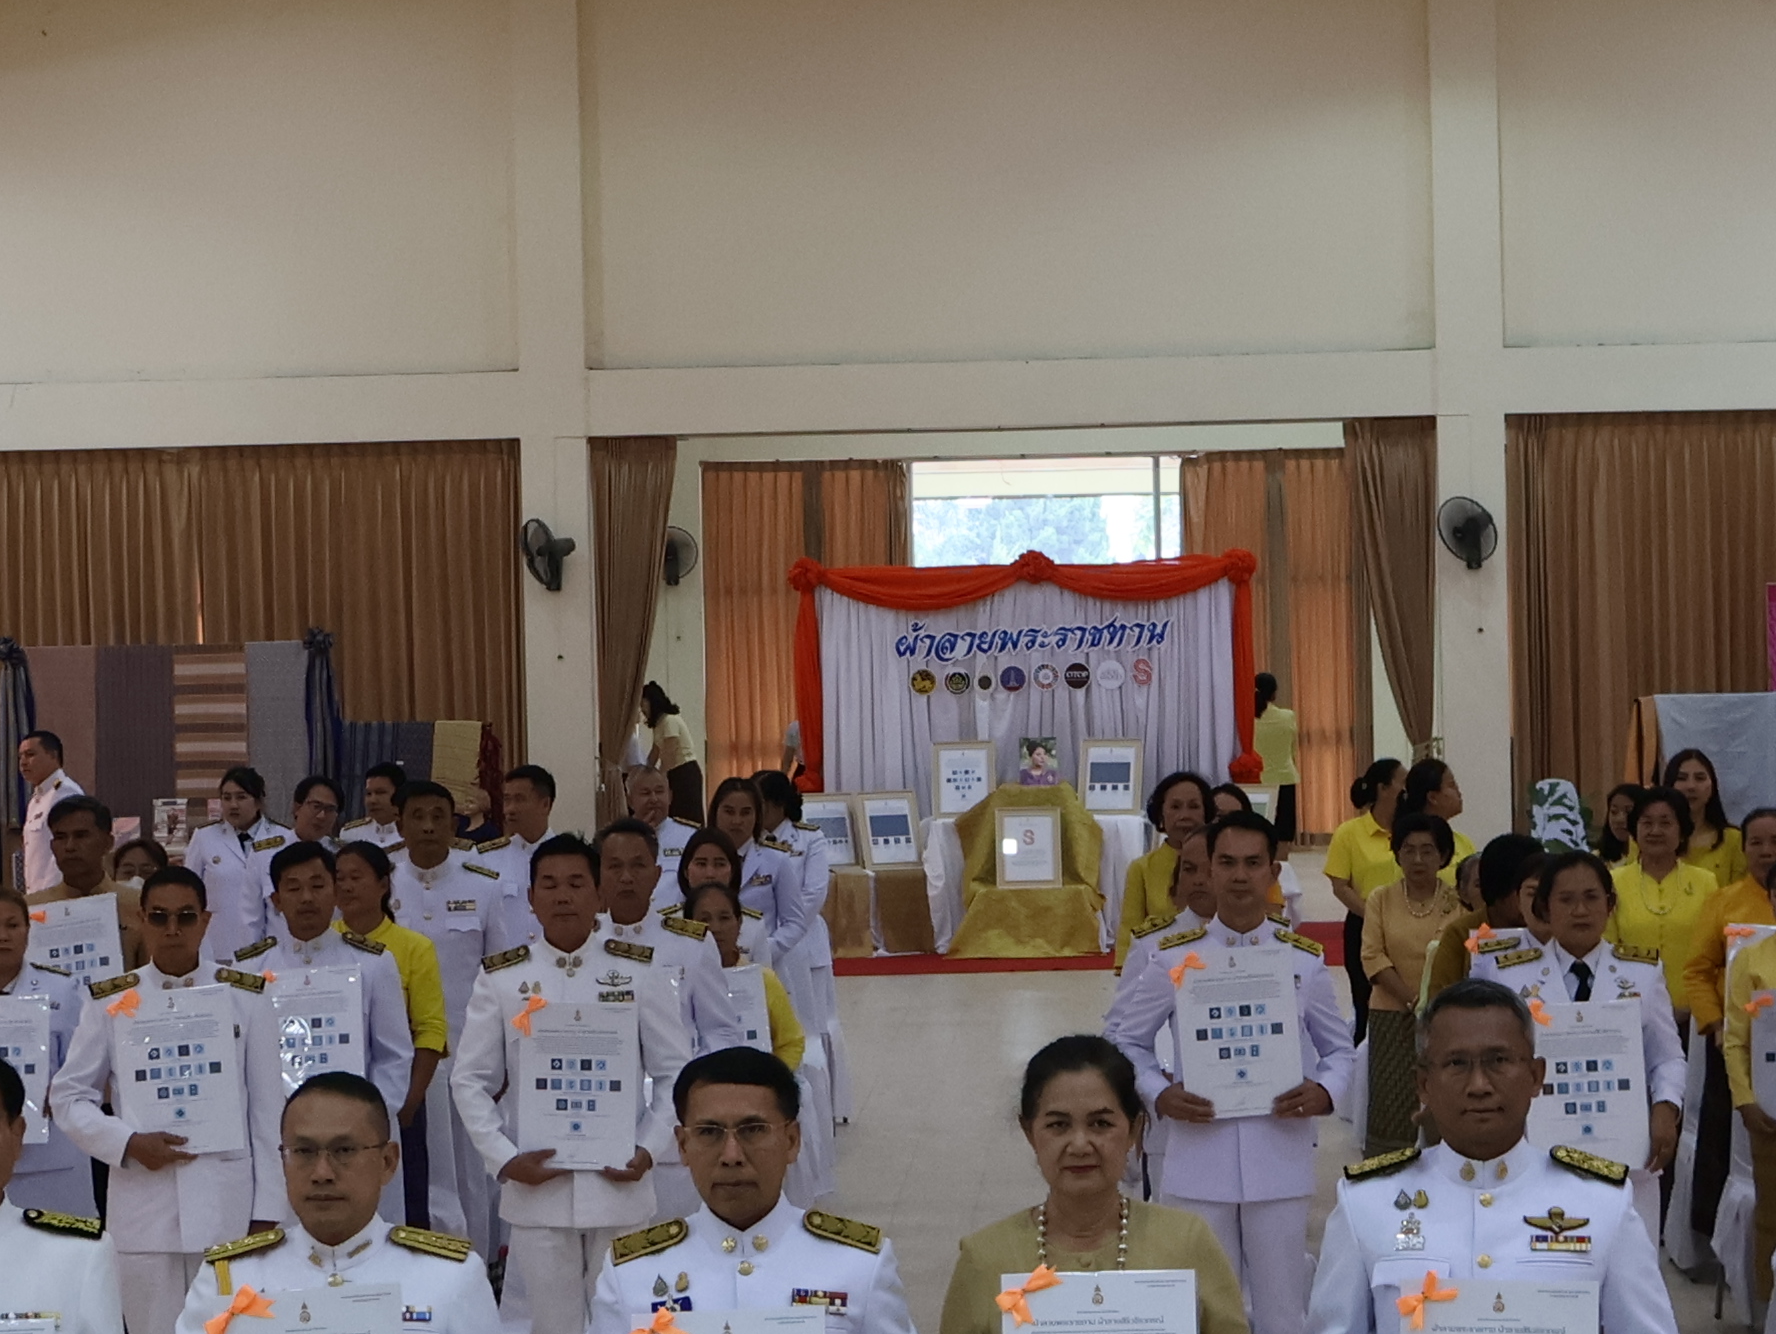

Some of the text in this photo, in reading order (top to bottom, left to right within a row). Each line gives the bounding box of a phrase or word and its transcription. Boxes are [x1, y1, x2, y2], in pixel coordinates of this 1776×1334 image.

[895, 616, 1170, 662] ผ้าลายพระราชทาน
